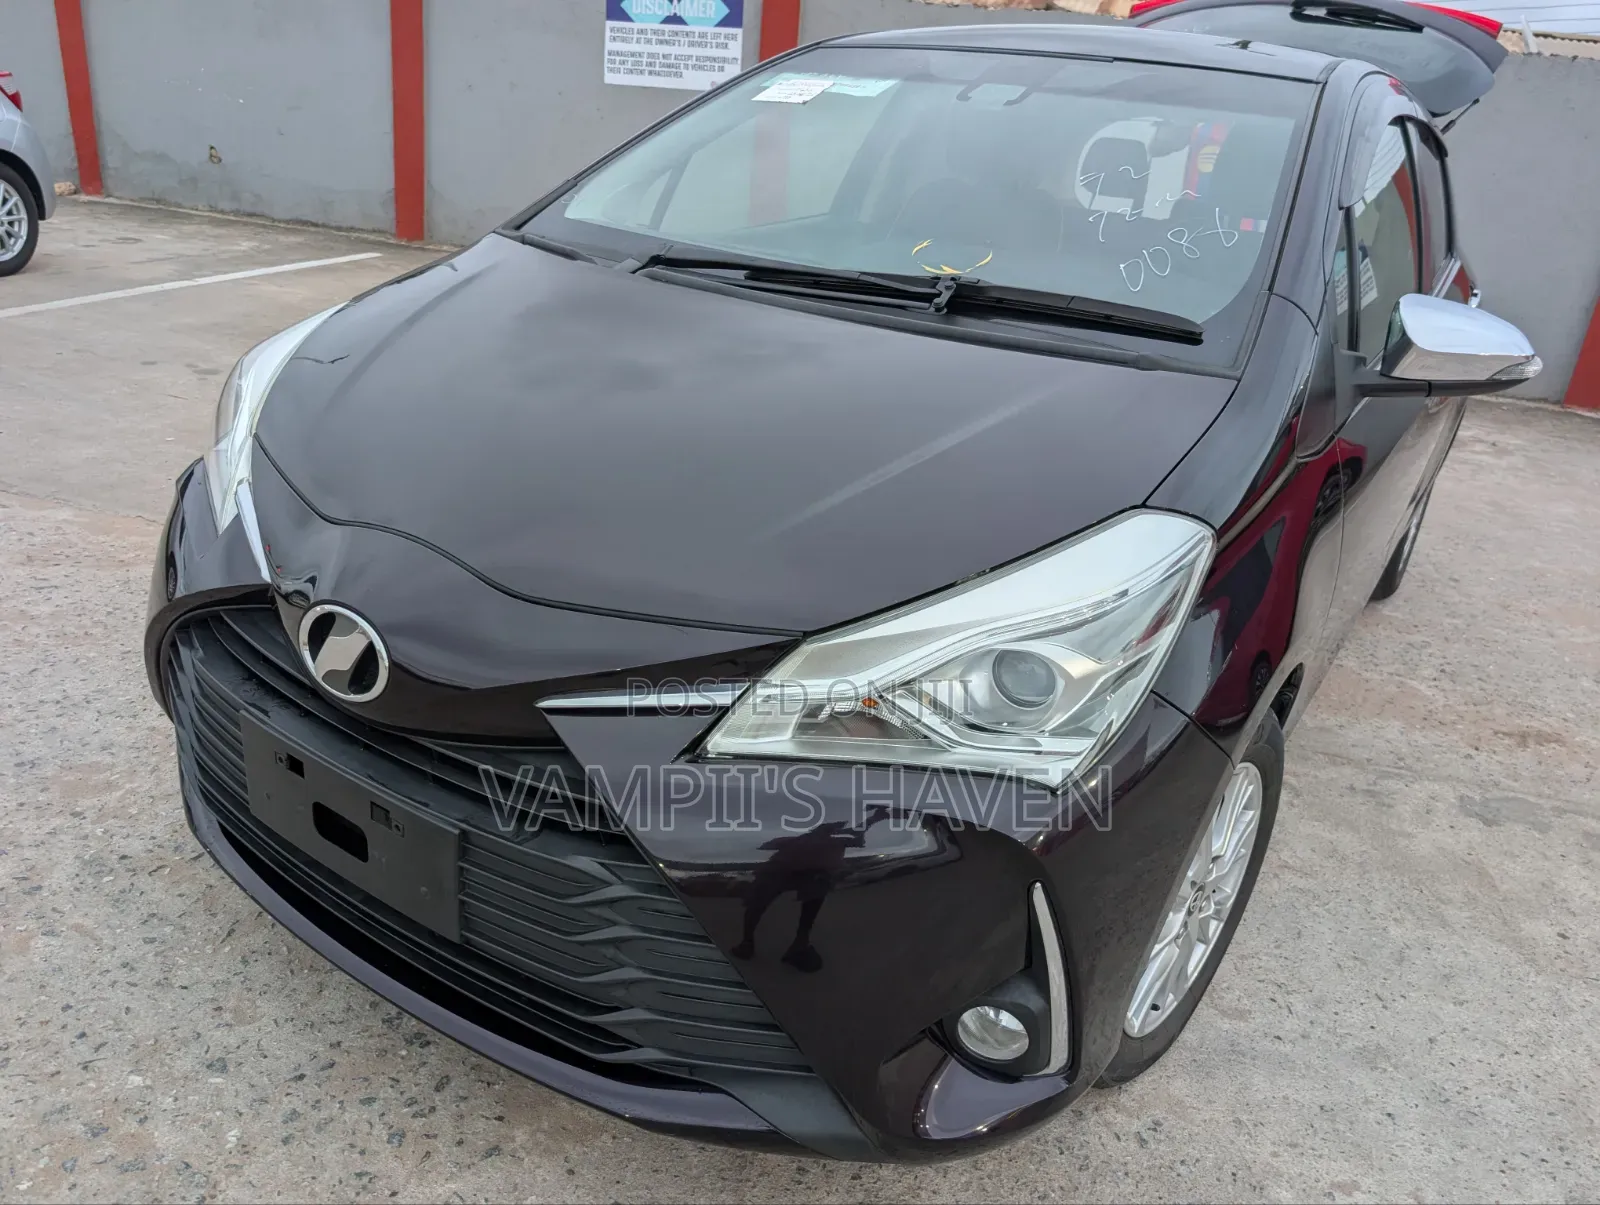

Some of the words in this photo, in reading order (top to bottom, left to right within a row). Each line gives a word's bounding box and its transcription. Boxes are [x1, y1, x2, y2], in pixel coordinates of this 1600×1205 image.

[632, 0, 715, 18] DISCLAIMER
[609, 26, 634, 36] VEHICLES
[636, 28, 648, 36] AND
[650, 28, 666, 37] THEIR
[668, 30, 696, 38] CONTENTS
[698, 31, 709, 39] ARE
[710, 32, 722, 40] LEFT
[724, 33, 738, 42] HERE
[609, 35, 634, 44] ENTIRELY
[635, 36, 642, 44] AT
[644, 37, 654, 45] THE
[656, 38, 681, 47] OWNER'S
[687, 40, 713, 48] DRIVER'S
[607, 50, 646, 58] MANAGEMENT
[646, 52, 660, 60] DOES
[662, 53, 673, 61] NOT
[675, 54, 694, 62] ACCEPT
[695, 56, 739, 64] RESPONSIBILITY
[607, 58, 616, 66] FOR
[631, 60, 644, 68] LOSS
[659, 62, 682, 70] DAMAGE
[691, 64, 716, 72] VEHICLES
[607, 66, 621, 74] THEIR
[623, 68, 646, 76] CONTENT
